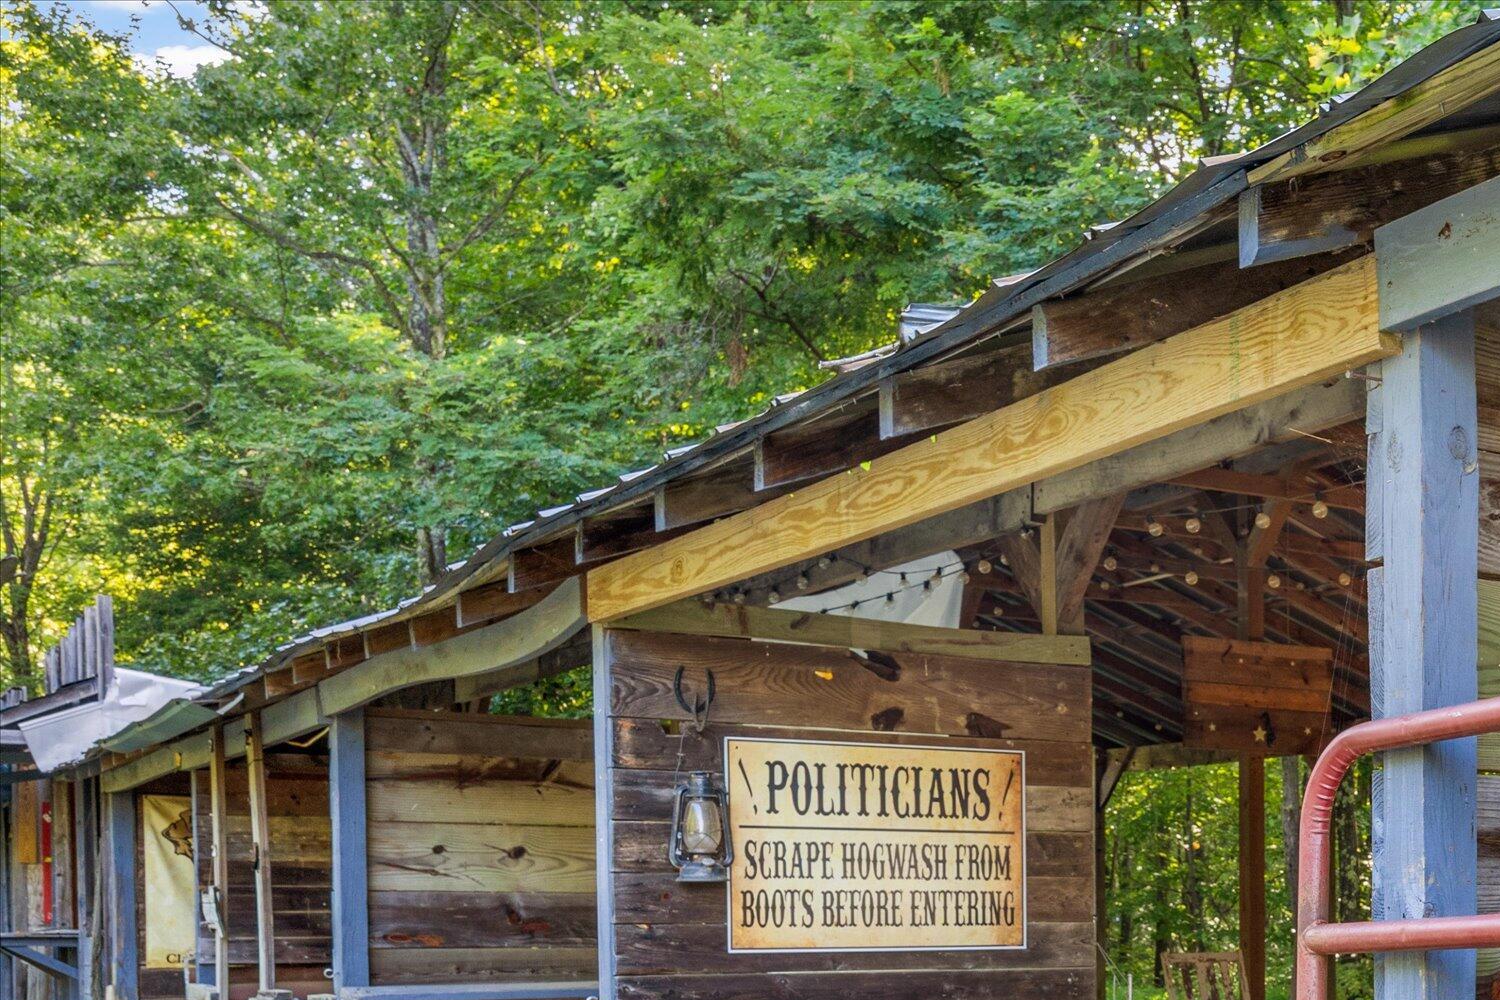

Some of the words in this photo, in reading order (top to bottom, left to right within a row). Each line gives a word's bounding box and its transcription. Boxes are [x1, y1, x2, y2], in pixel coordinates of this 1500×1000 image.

[744, 839, 834, 881] SCRAPE
[841, 841, 948, 882] HOGWASH
[955, 844, 1012, 882] FROM
[741, 888, 814, 929] BOOTS
[821, 889, 904, 928] BEFORE
[910, 889, 1015, 928] ENTERING
